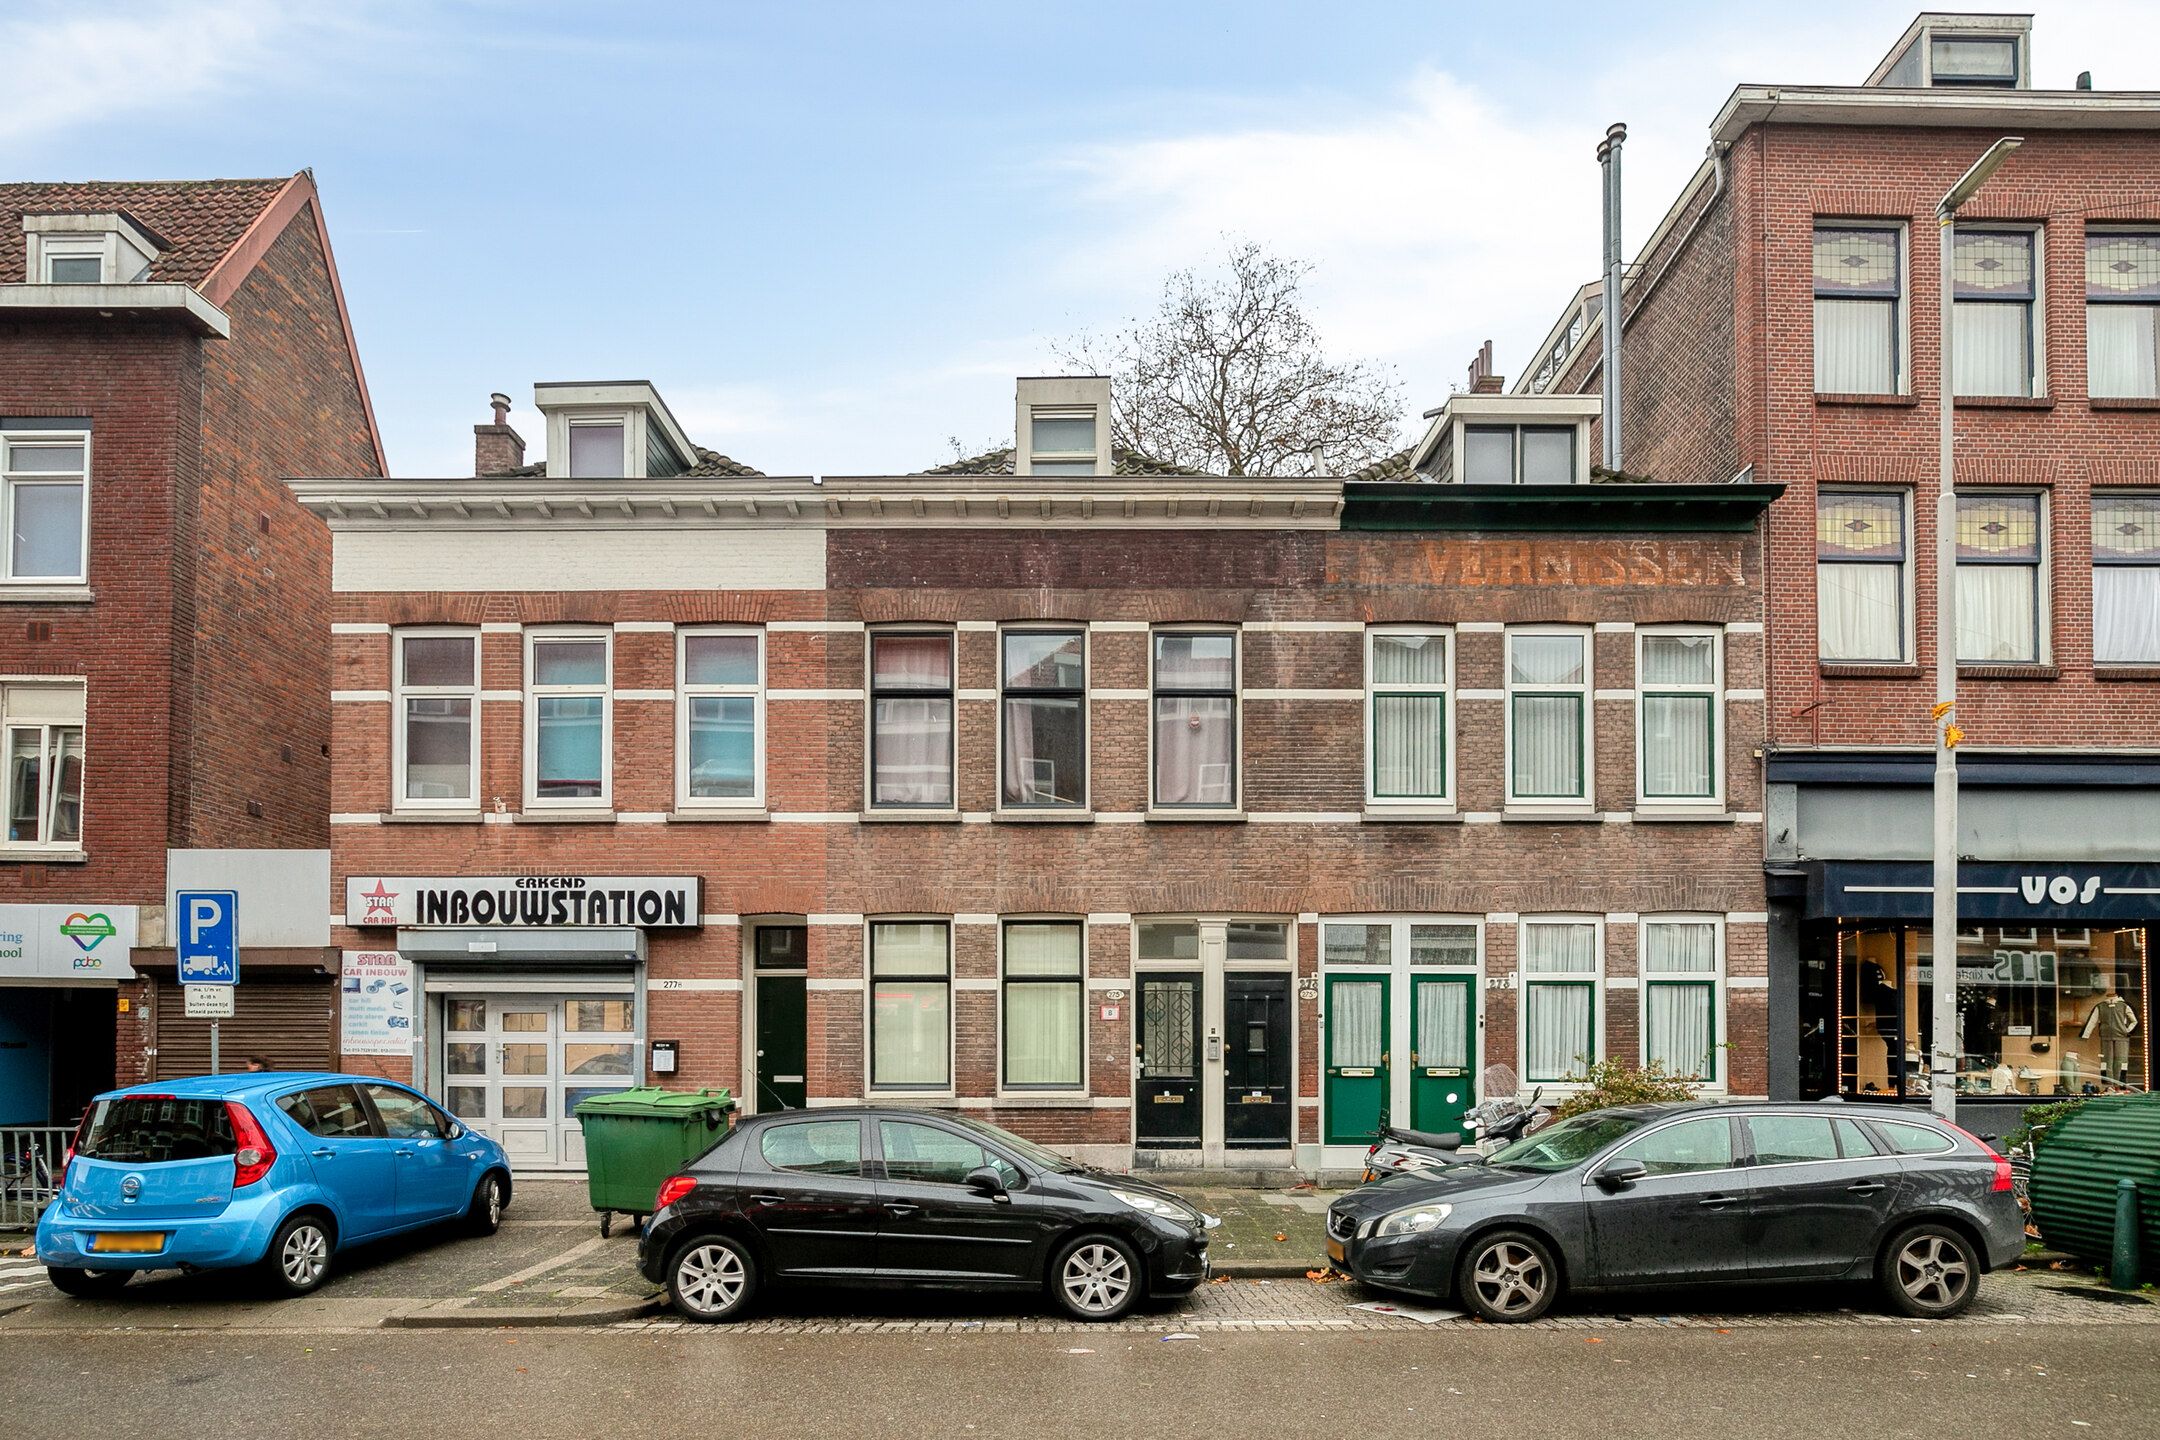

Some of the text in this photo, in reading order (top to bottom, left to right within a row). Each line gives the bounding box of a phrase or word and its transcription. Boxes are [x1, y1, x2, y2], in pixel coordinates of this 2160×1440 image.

[1419, 540, 1745, 585] VERNISSEN
[515, 878, 586, 888] ERKEND
[2021, 876, 2100, 904] VOS
[366, 896, 395, 907] STAR
[416, 890, 686, 925] INBOUWSTATION
[190, 899, 222, 944] P
[357, 954, 396, 966] STAR
[343, 968, 408, 976] CAR INBOUW
